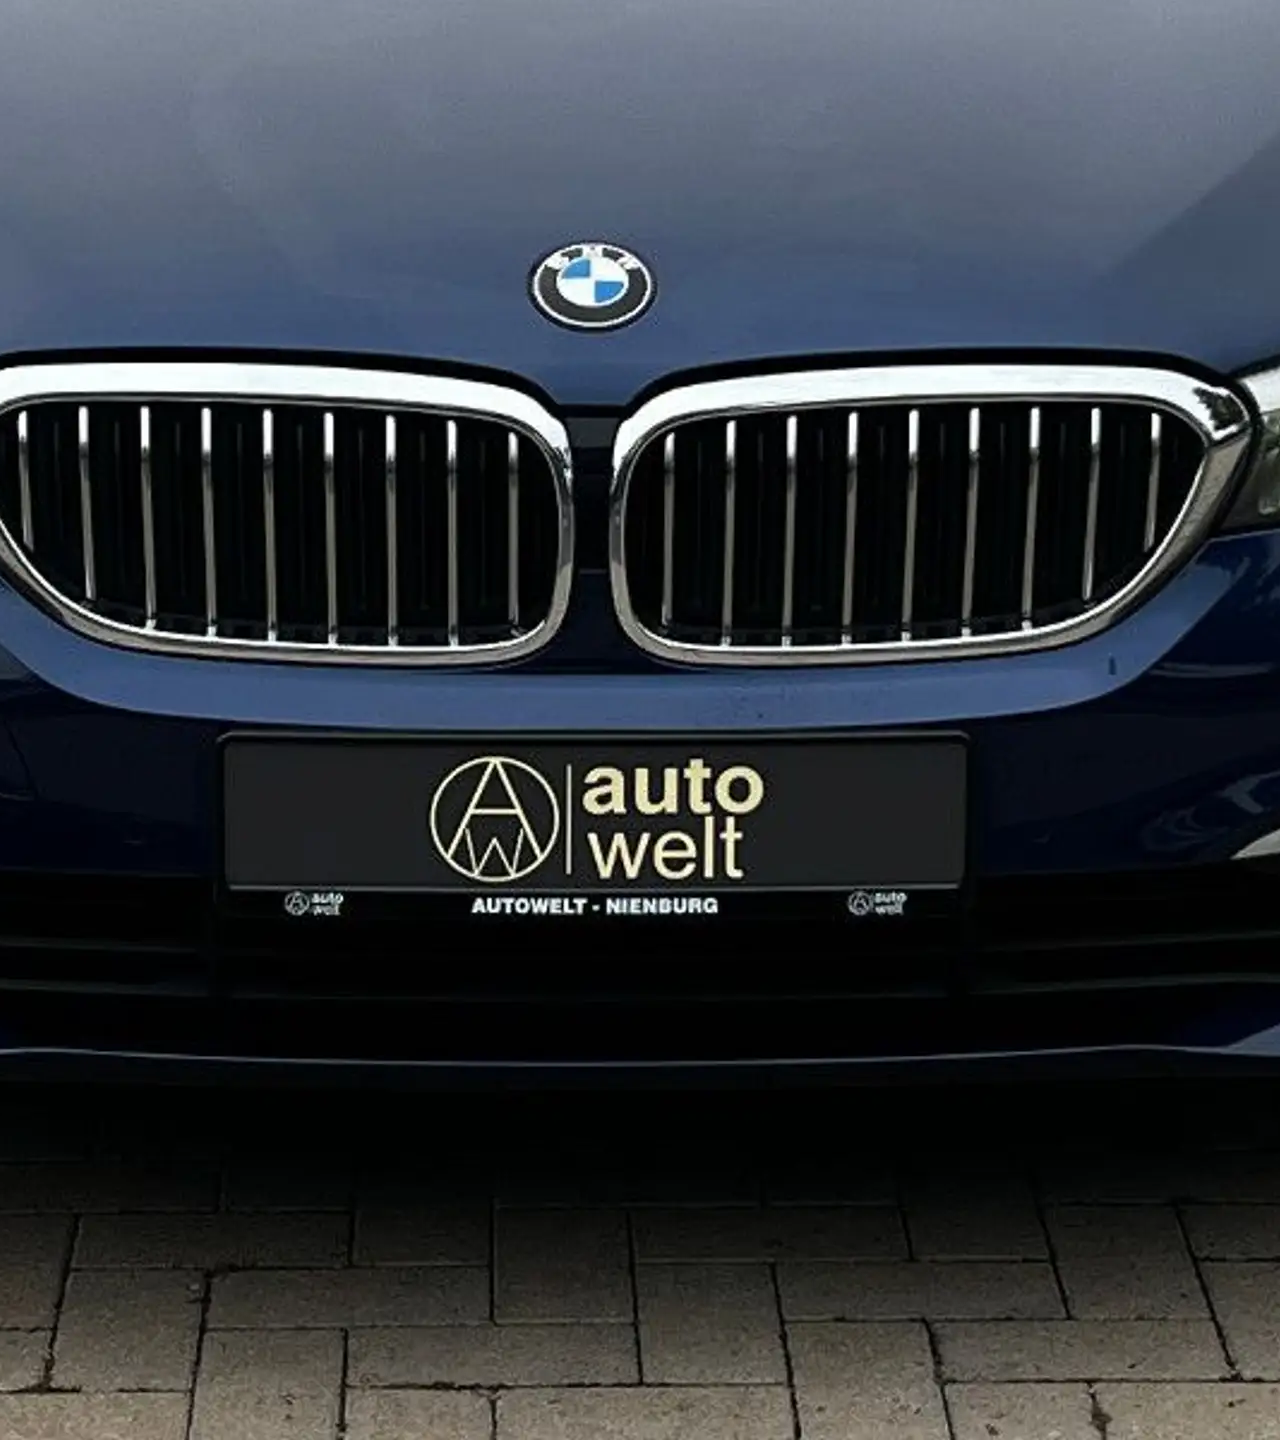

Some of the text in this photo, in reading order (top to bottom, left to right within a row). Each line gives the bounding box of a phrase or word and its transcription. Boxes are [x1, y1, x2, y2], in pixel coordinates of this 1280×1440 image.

[582, 758, 764, 815] auto
[587, 816, 744, 879] welt
[471, 897, 588, 915] AUTOWELT
[606, 897, 719, 915] NIENBURG
